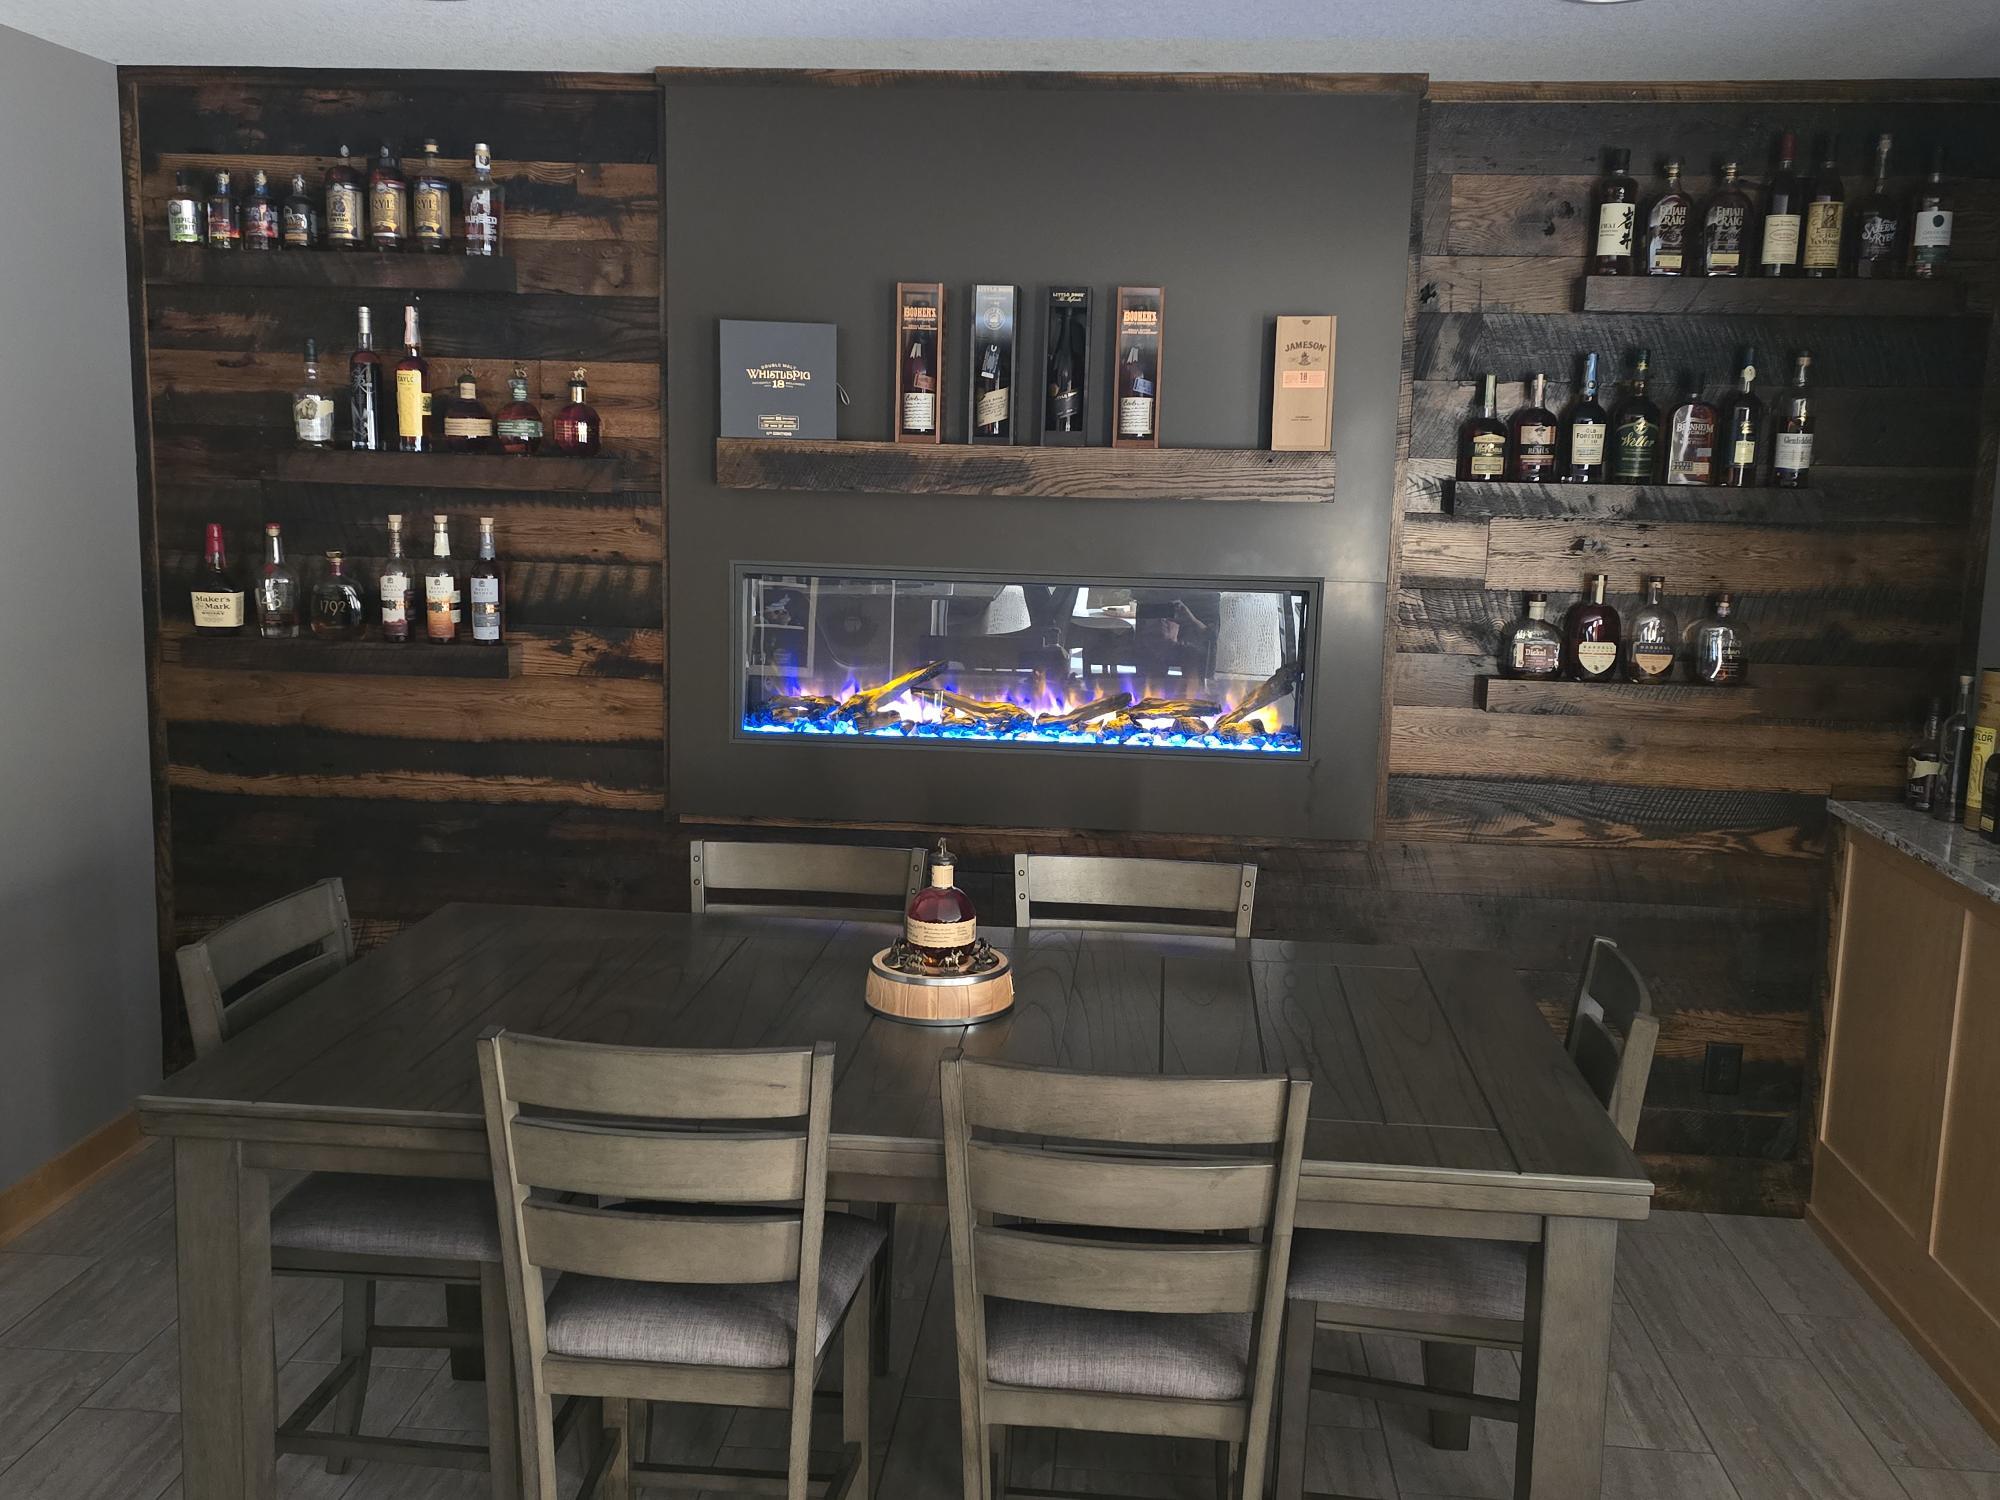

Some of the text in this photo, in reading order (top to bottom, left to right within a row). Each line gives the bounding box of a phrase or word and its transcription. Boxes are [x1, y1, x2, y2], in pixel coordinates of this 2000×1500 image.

[1617, 206, 1634, 250] 岩井
[1284, 341, 1325, 353] JAMESON
[746, 368, 811, 381] WHISTLEPIG
[772, 379, 785, 389] 18
[1676, 422, 1715, 433] BENHEIM
[1621, 432, 1656, 448] Weller
[195, 595, 231, 603] Maker's
[320, 599, 347, 616] 1792
[1525, 648, 1547, 656] Dickel
